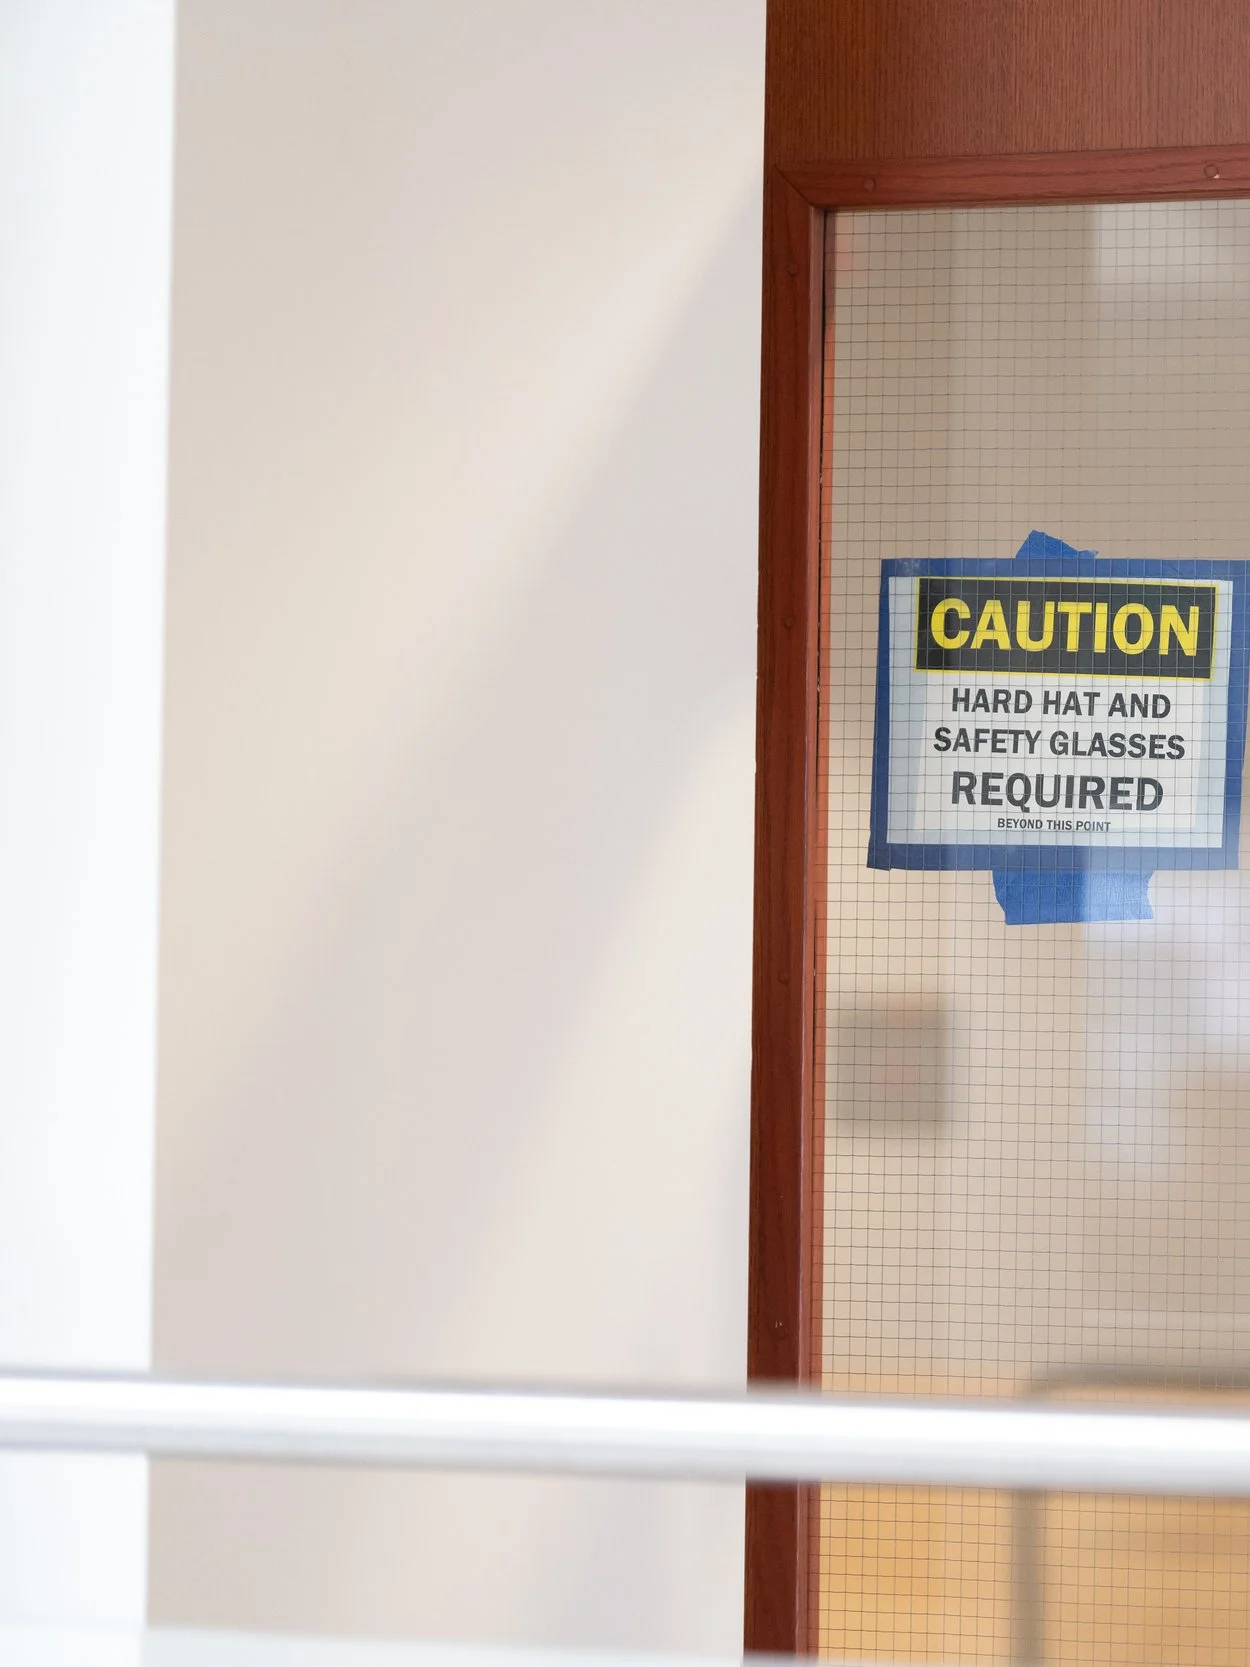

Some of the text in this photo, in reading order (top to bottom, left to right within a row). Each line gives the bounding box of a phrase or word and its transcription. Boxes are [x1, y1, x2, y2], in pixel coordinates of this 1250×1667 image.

[930, 597, 1200, 657] CAUTION
[951, 687, 1171, 719] HARD HAT AND
[933, 727, 1186, 760] SAFETY GLASSES
[951, 770, 1164, 813] REQUIRED
[997, 817, 1111, 832] BEYOND THIS POINT
